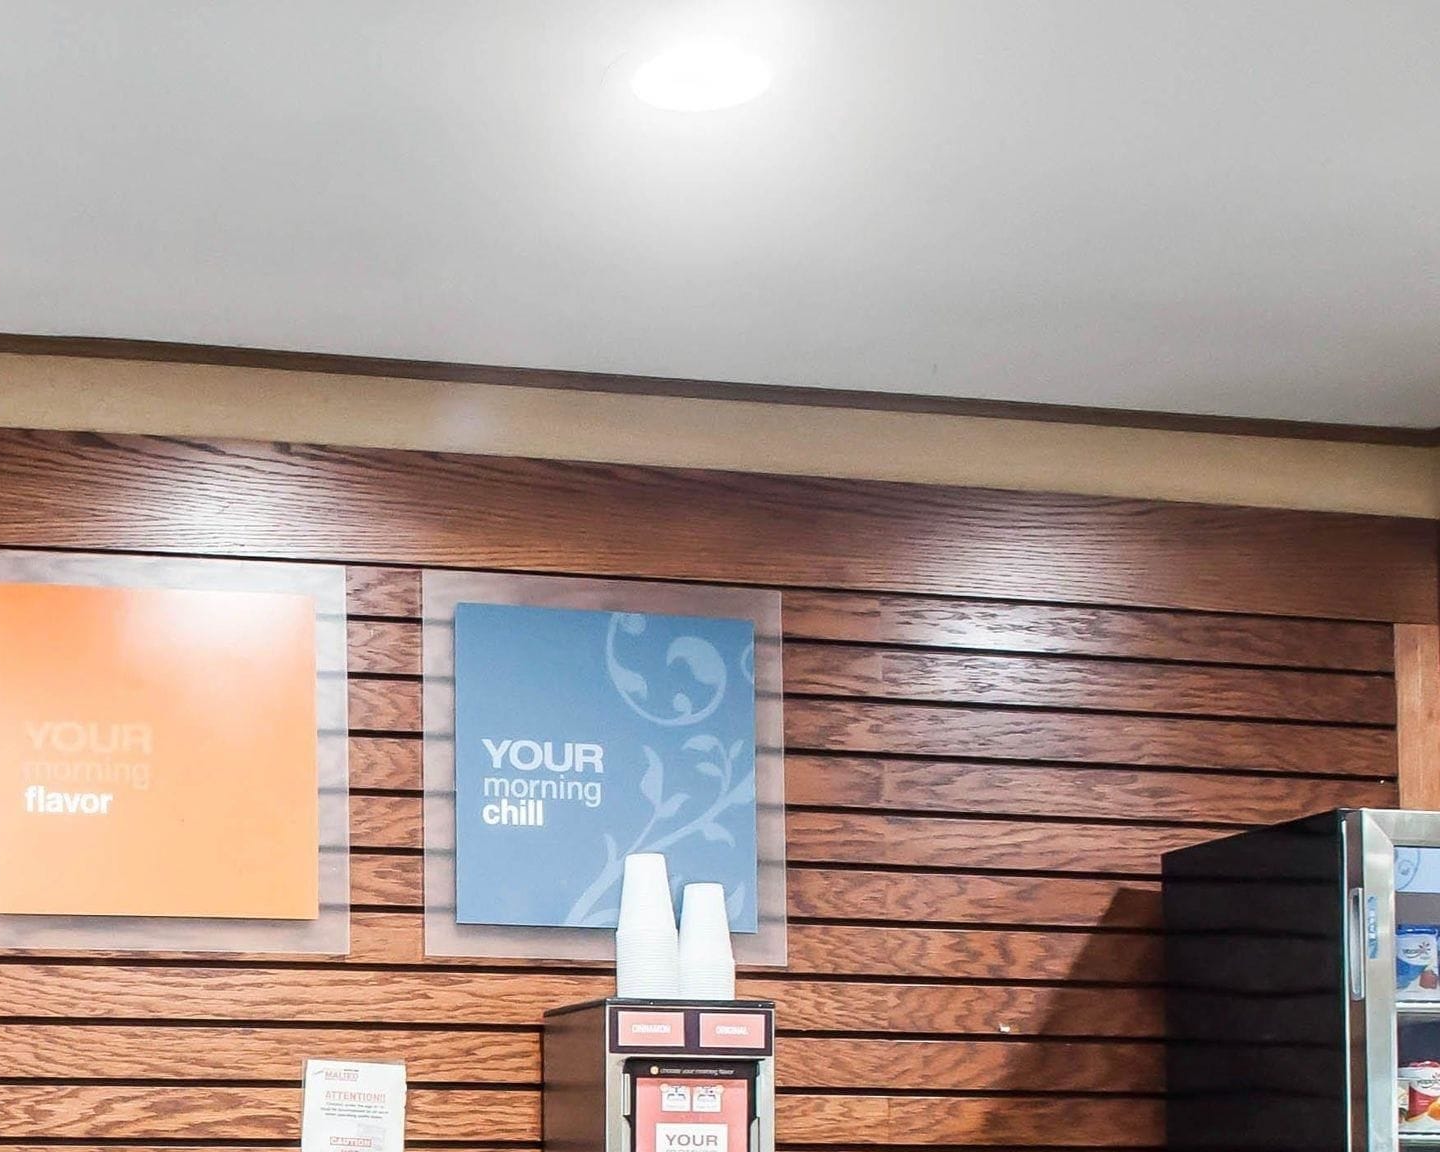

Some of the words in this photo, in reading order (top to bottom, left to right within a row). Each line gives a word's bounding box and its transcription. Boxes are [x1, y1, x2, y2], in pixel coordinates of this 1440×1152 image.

[23, 720, 153, 755] YOUR
[481, 738, 605, 774] YOUR
[22, 757, 151, 791] morning
[483, 774, 602, 808] morning
[24, 784, 114, 815] flavor
[482, 798, 545, 827] chill
[665, 1134, 718, 1147] YOUR
